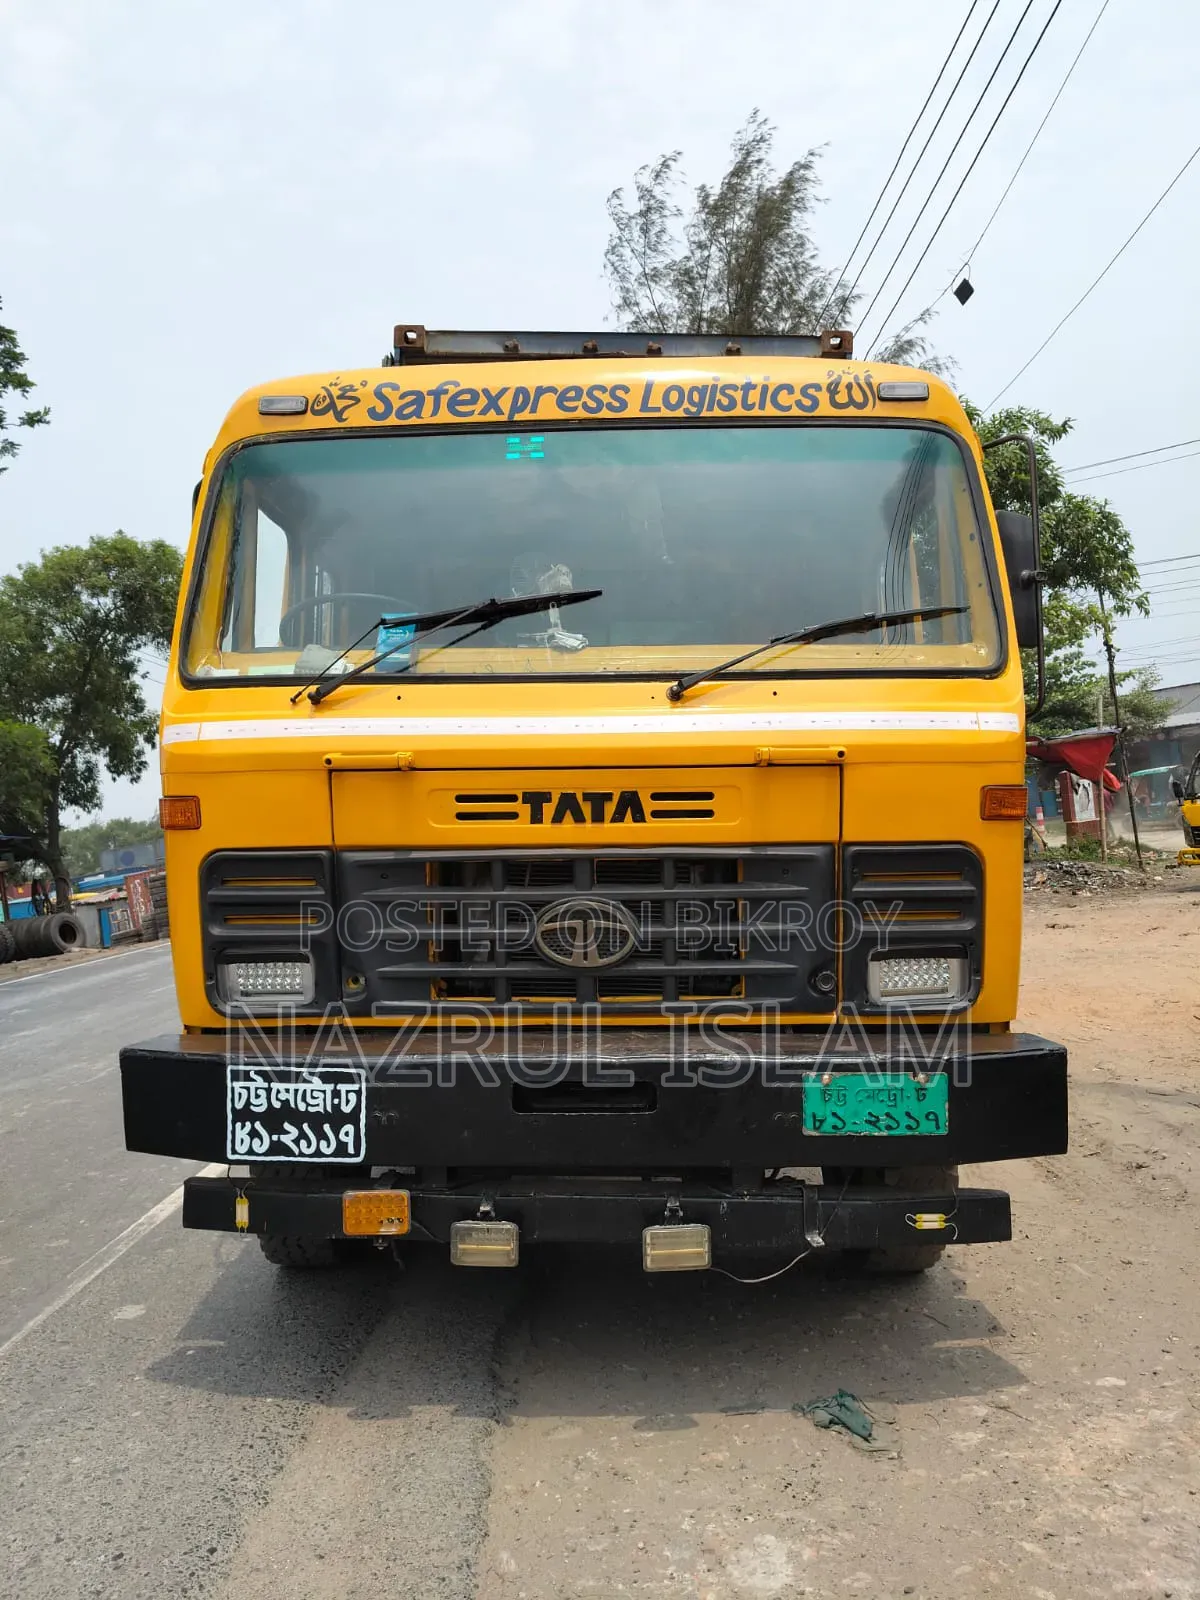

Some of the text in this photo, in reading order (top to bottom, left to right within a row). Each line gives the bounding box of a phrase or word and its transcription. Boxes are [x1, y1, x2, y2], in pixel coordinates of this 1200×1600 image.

[367, 375, 822, 421] Safexpress Logistics
[522, 791, 647, 824] TATA
